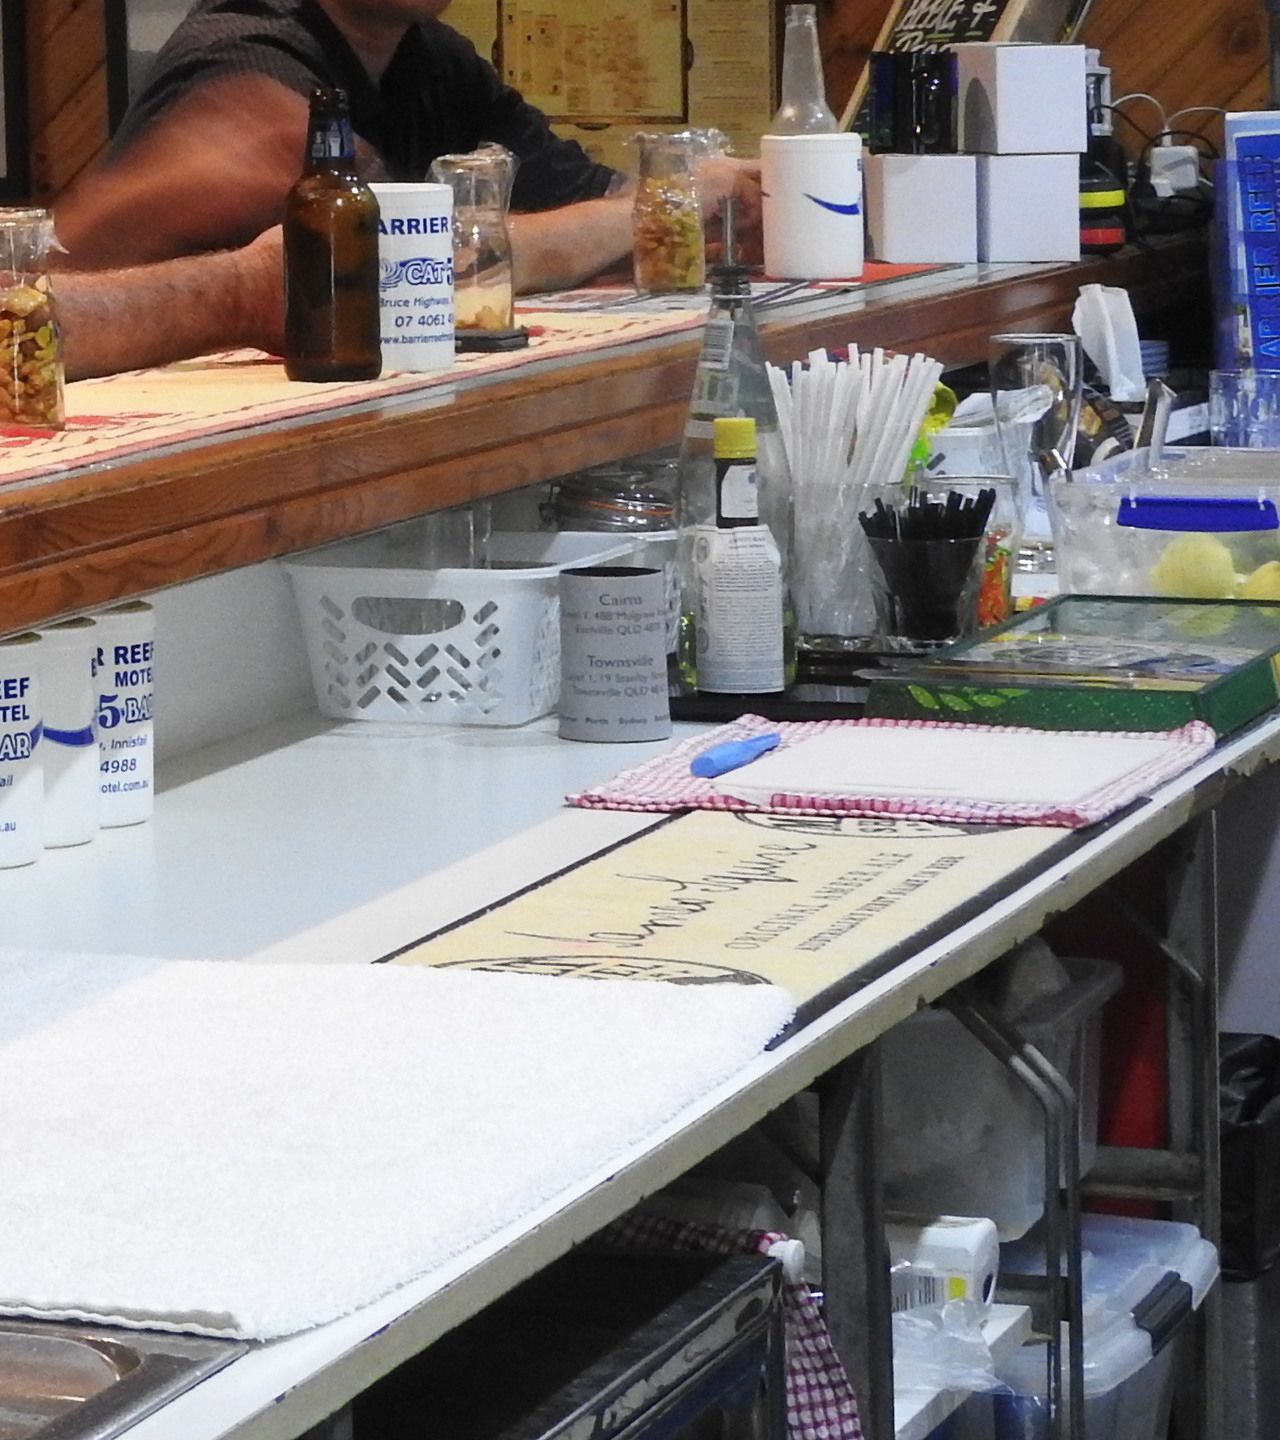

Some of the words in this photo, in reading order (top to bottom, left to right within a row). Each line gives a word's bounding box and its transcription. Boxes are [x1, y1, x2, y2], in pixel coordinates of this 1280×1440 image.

[378, 216, 449, 236] ARRIER
[405, 260, 445, 287] CAT
[394, 315, 414, 328] 07
[417, 314, 446, 327] 4061
[114, 666, 152, 688] MOTE
[125, 693, 153, 724] BA
[724, 903, 828, 951] ORIGINAL
[809, 869, 883, 902] AMBER
[863, 851, 913, 869] ALE
